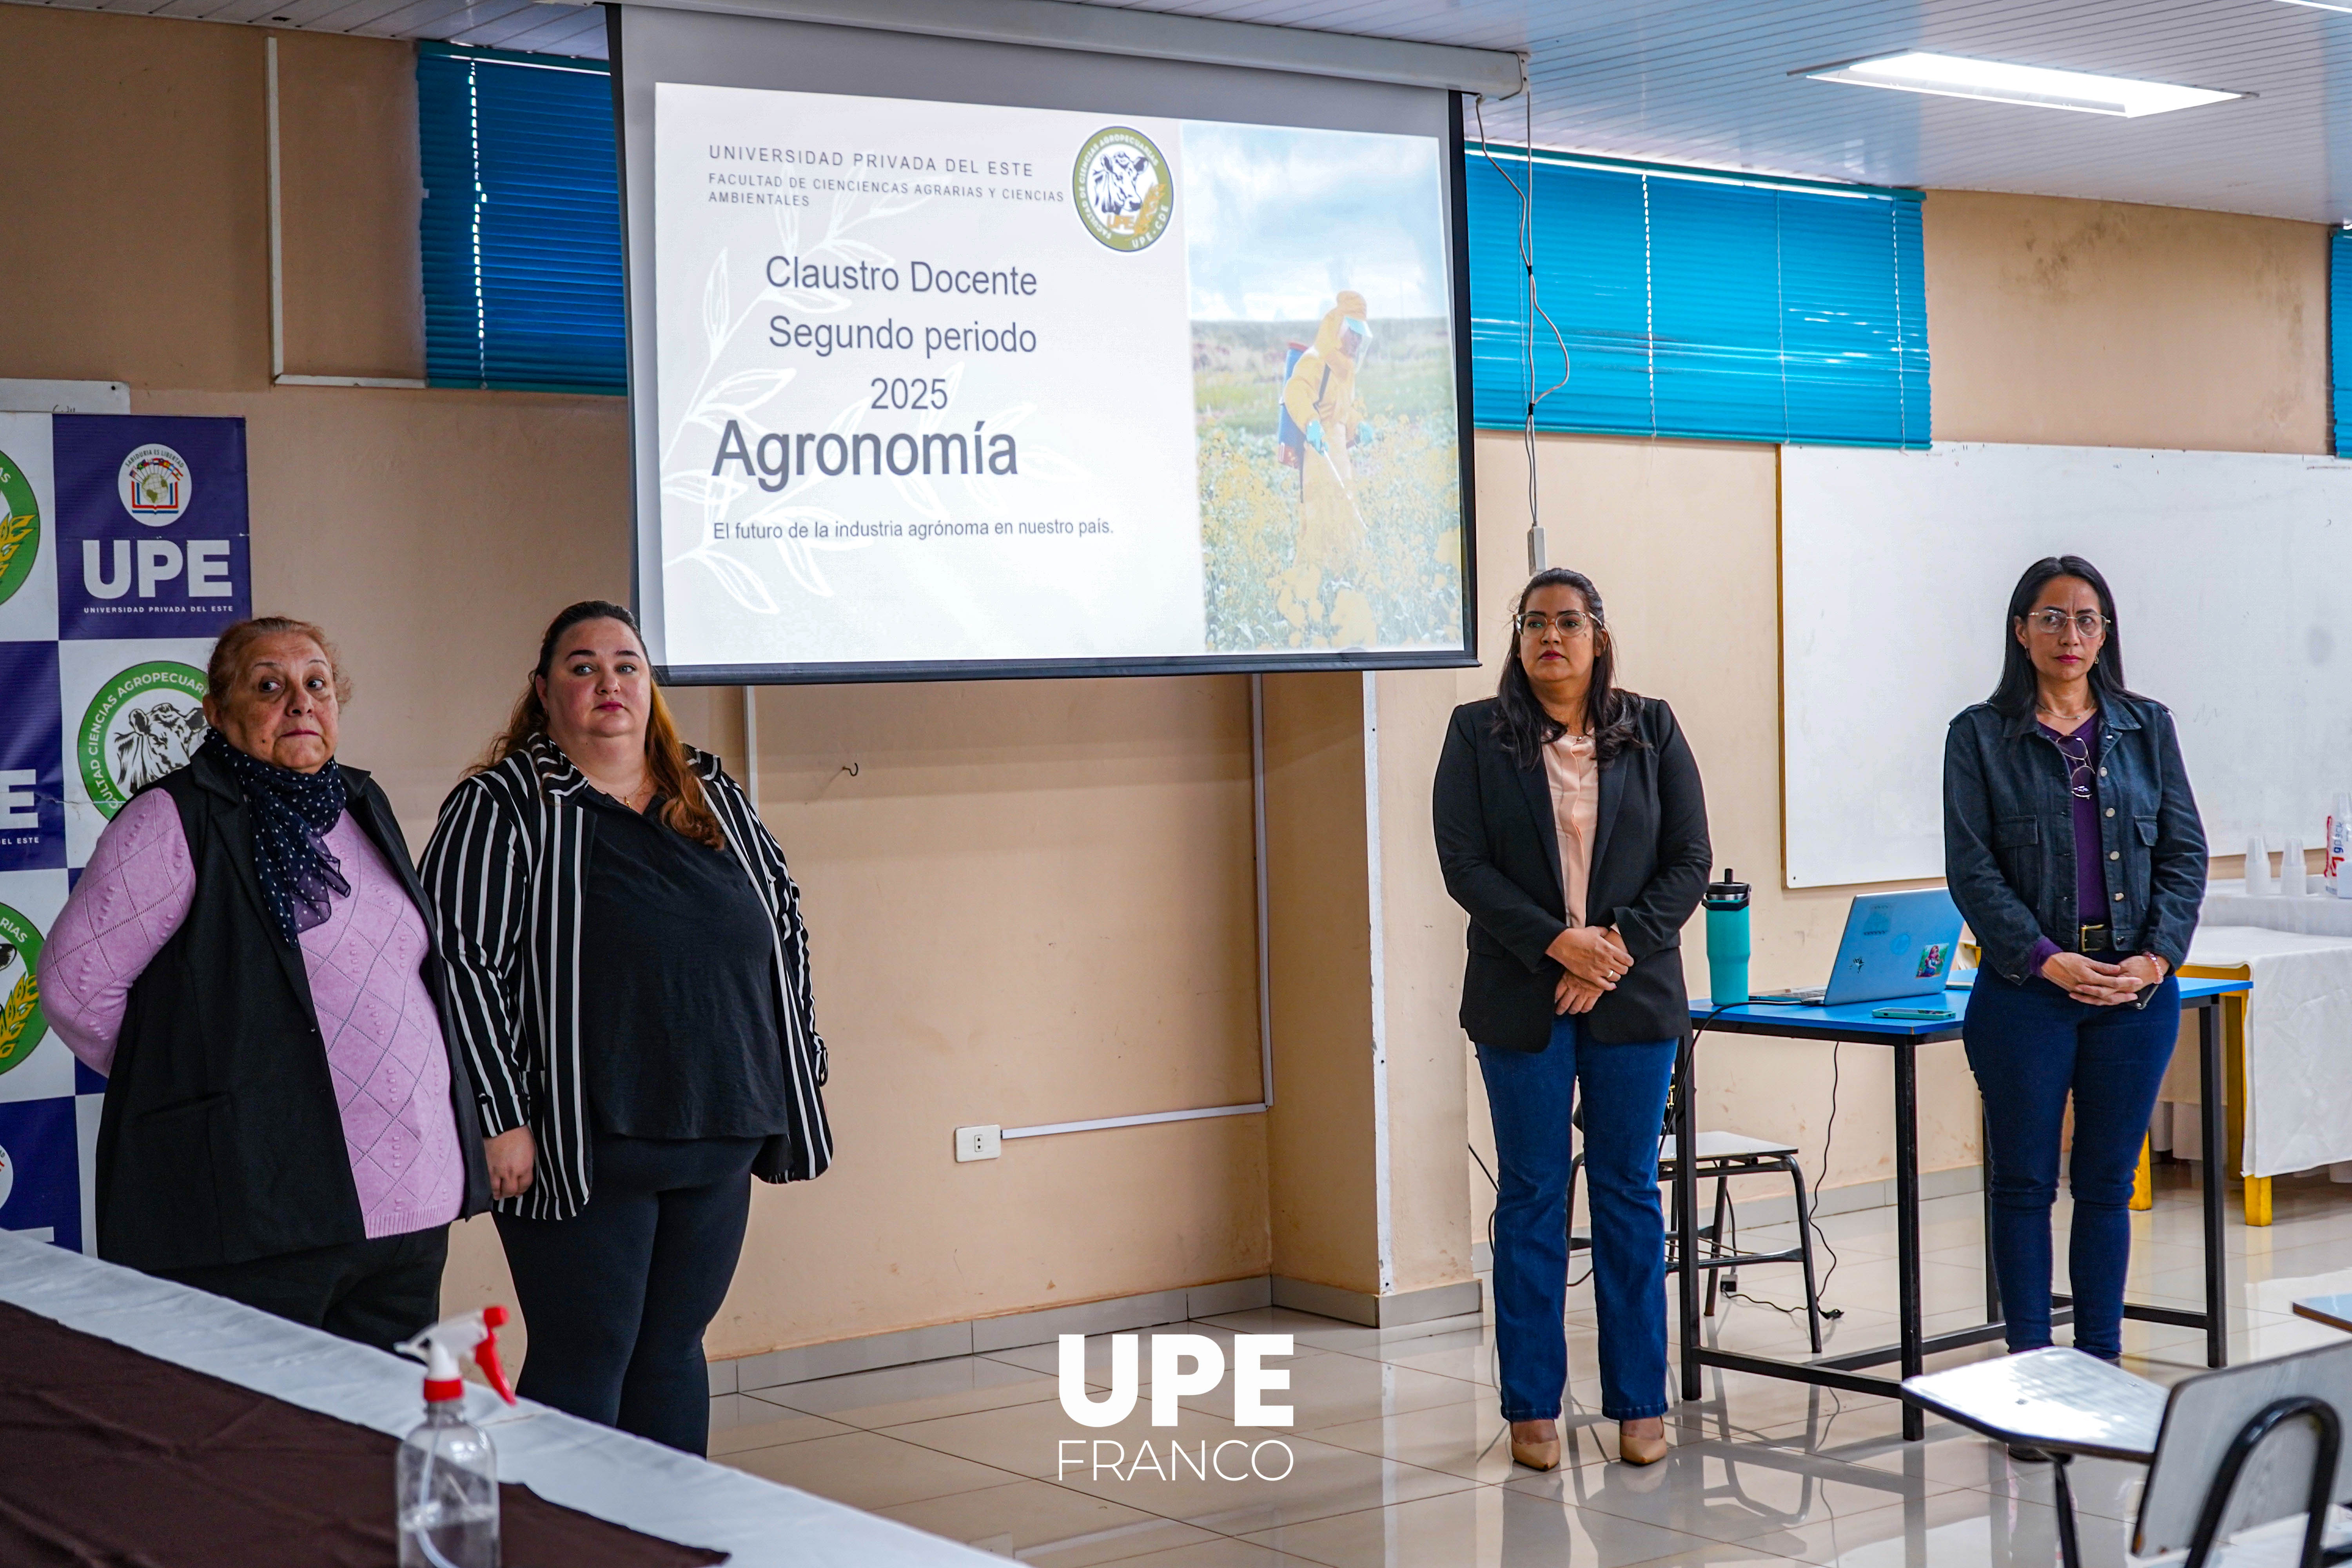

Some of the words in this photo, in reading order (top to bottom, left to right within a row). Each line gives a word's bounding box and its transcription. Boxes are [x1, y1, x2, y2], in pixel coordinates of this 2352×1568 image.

[710, 145, 843, 165] UNIVERSIDAD
[854, 153, 936, 171] PRIVADA
[946, 158, 978, 173] DEL
[988, 161, 1033, 177] ESTE
[708, 191, 809, 206] AMBIENTALES
[709, 173, 782, 187] FACULTAD
[789, 177, 806, 189] DE
[813, 179, 908, 194] CIENCIENCAS
[914, 184, 983, 198] AGRARIAS
[988, 188, 996, 198] Y
[1002, 189, 1064, 202] CIENCIAS
[766, 255, 900, 292] Claustro
[911, 261, 1038, 296] Docente
[769, 315, 914, 358] Segundo
[925, 320, 1037, 359] periodo
[870, 377, 949, 410] 2025
[711, 419, 1018, 493] Agronomía
[713, 522, 730, 540] El
[735, 522, 783, 539] futuro
[788, 522, 809, 539] de
[814, 521, 829, 539] la
[835, 520, 903, 538] industria
[908, 520, 989, 541] agrónoma
[994, 522, 1013, 535] en
[1019, 519, 1074, 535] nuestro
[1079, 517, 1114, 538] país.
[82, 539, 232, 599] UPE
[88, 695, 117, 755] CIENCIAS
